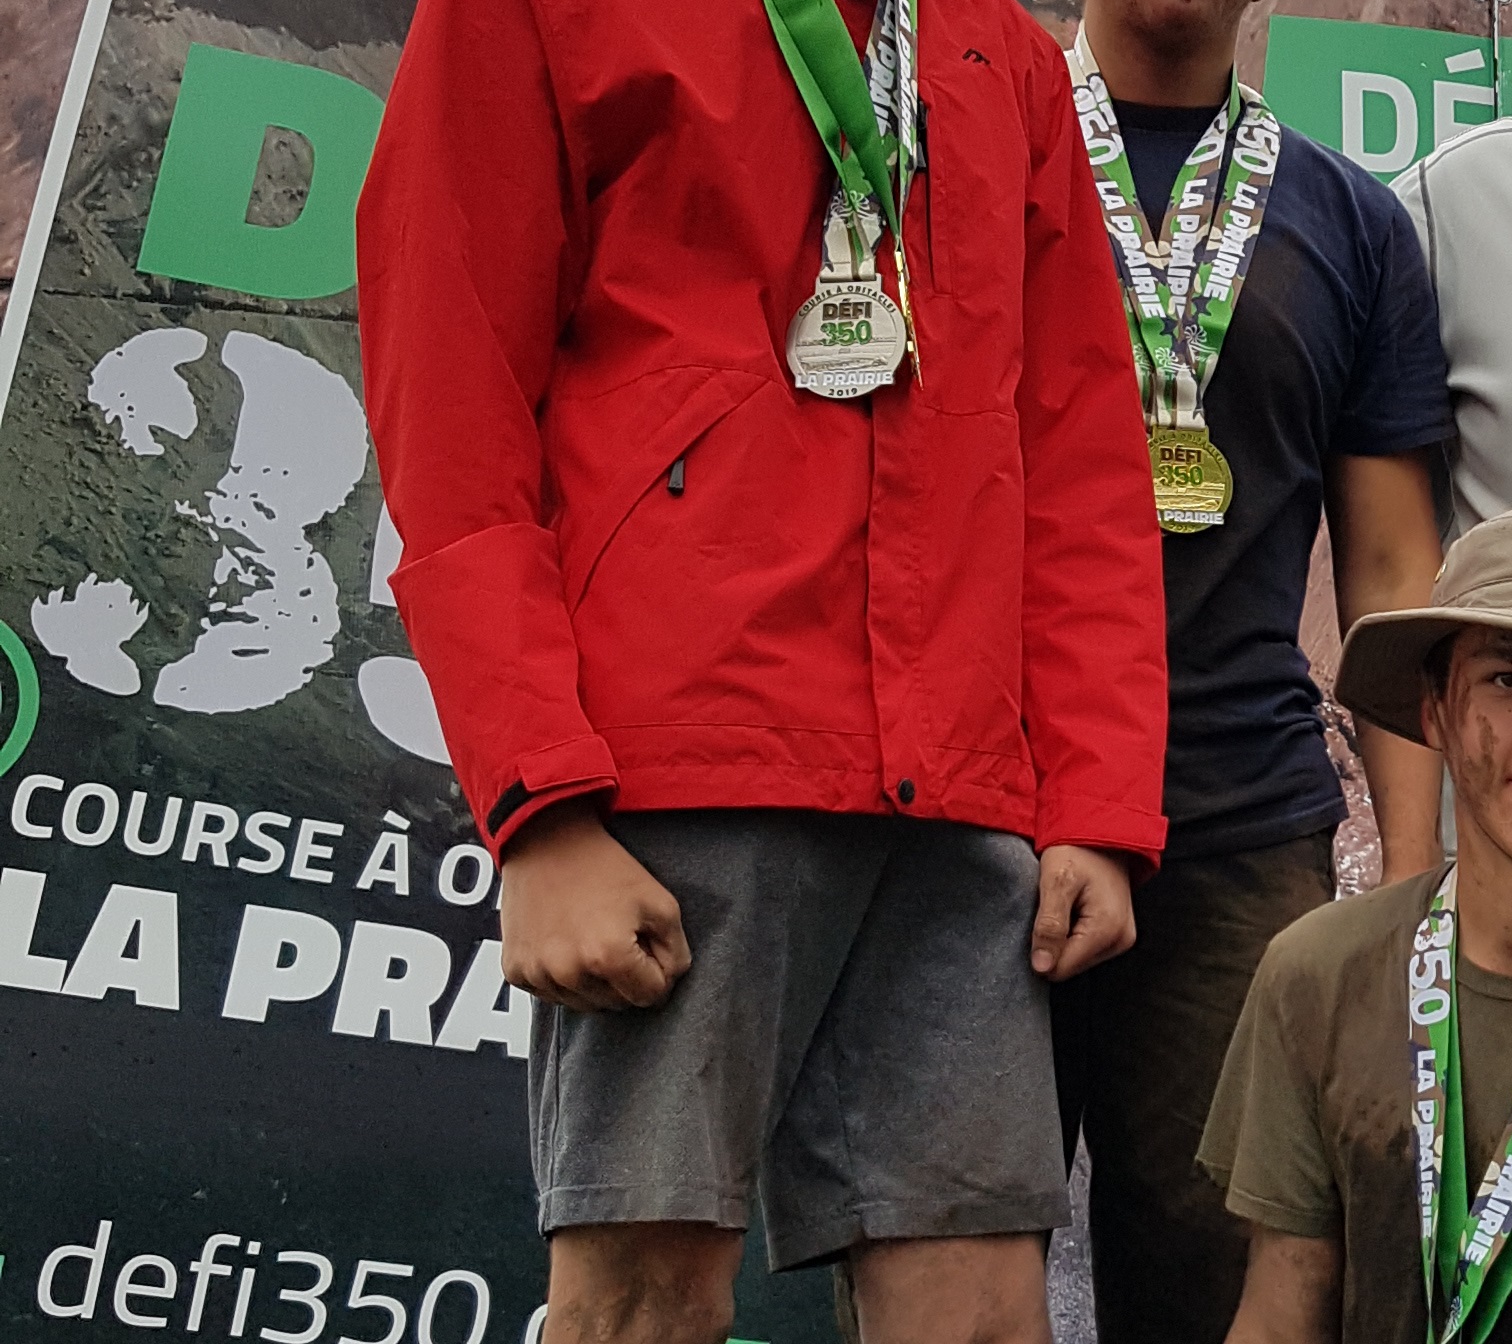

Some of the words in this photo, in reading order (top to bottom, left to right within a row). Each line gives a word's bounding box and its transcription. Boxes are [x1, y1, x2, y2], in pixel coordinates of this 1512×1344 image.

[1233, 109, 1282, 175] 350
[1095, 179, 1127, 210] LA
[1179, 178, 1208, 209] LA
[1231, 180, 1259, 210] LA
[1109, 213, 1167, 320] PRAIRIE
[1203, 212, 1253, 302] PRAIRIE
[821, 298, 873, 321] DÉFI
[820, 319, 873, 347] 350
[795, 373, 818, 388] LA
[822, 370, 895, 387] PRAIRIE
[828, 387, 858, 397] 2019
[1159, 443, 1203, 464] DÉFI
[1157, 463, 1204, 488] 350
[1163, 510, 1226, 525] PRAIRIE
[11, 773, 346, 884] COURSE
[356, 810, 411, 897] À
[437, 842, 504, 911] O
[0, 866, 181, 1012] LA
[1408, 911, 1455, 1026] 350
[1416, 1049, 1437, 1093] LA
[1416, 1098, 1436, 1239] PRAIRIE
